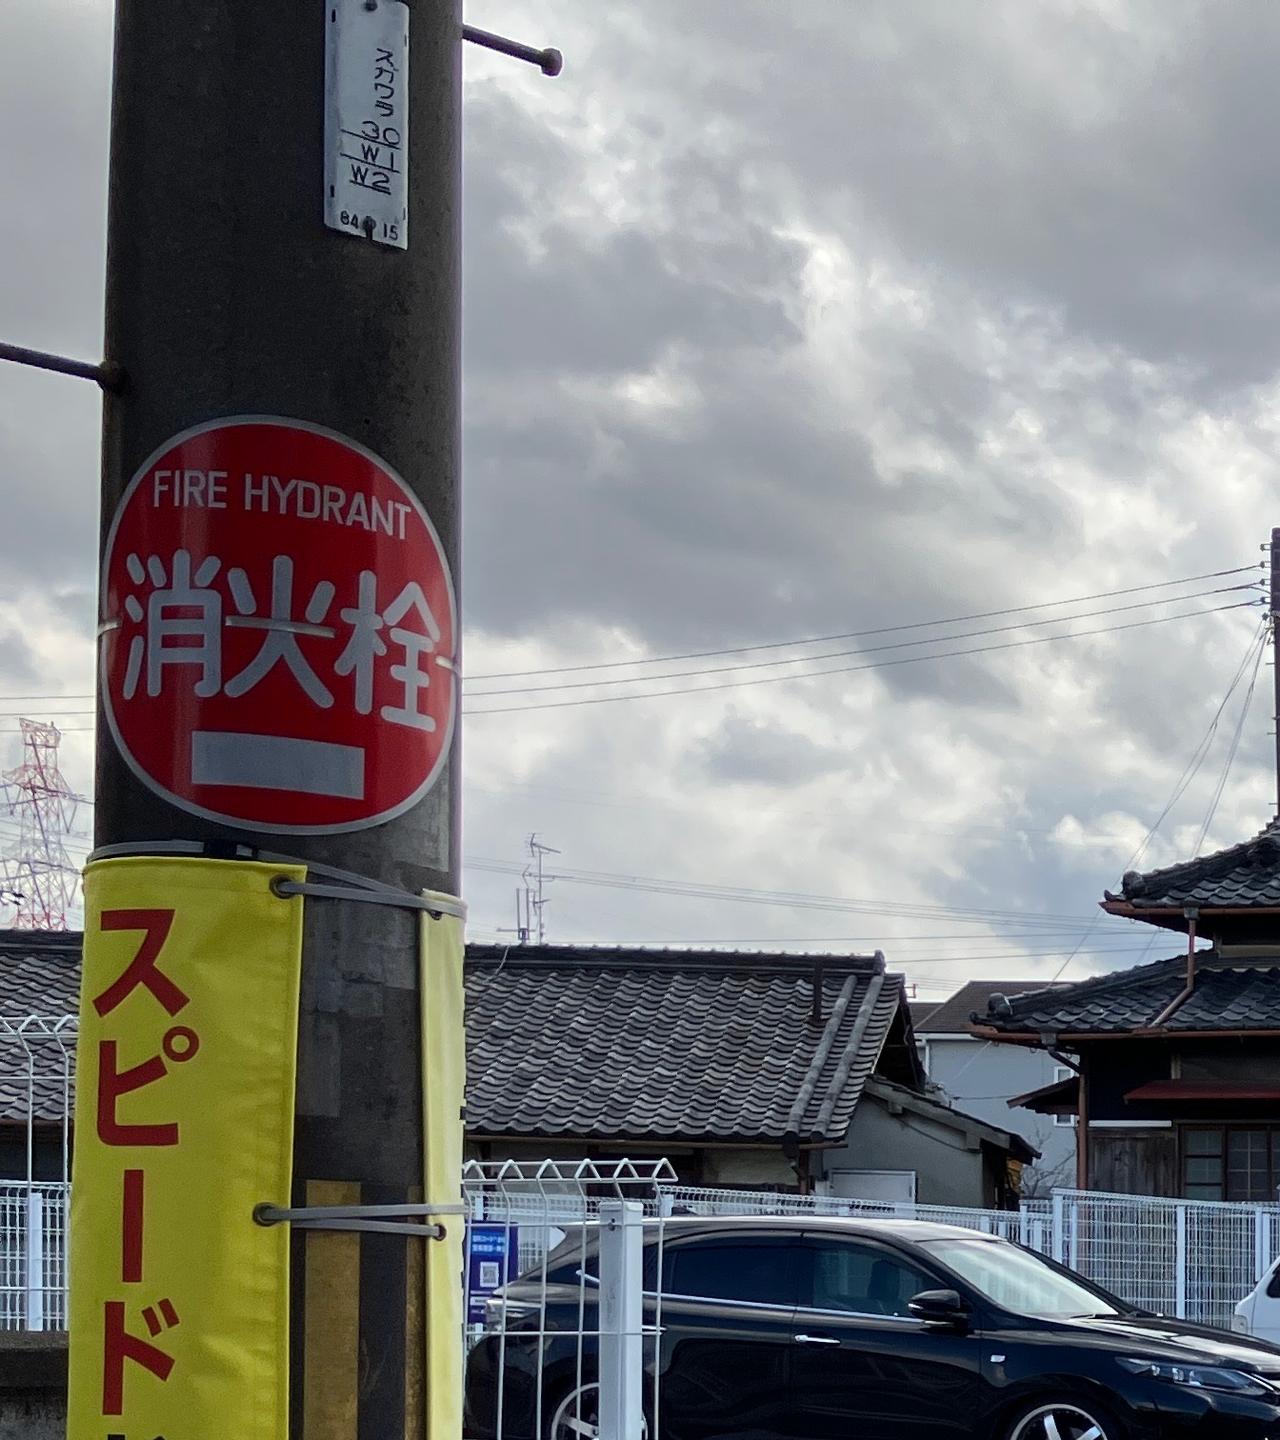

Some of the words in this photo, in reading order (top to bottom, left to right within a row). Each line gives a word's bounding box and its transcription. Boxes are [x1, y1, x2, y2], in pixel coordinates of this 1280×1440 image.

[152, 470, 229, 509] FIRE
[244, 473, 412, 540] HYDRANT
[122, 549, 441, 733] 消火栓
